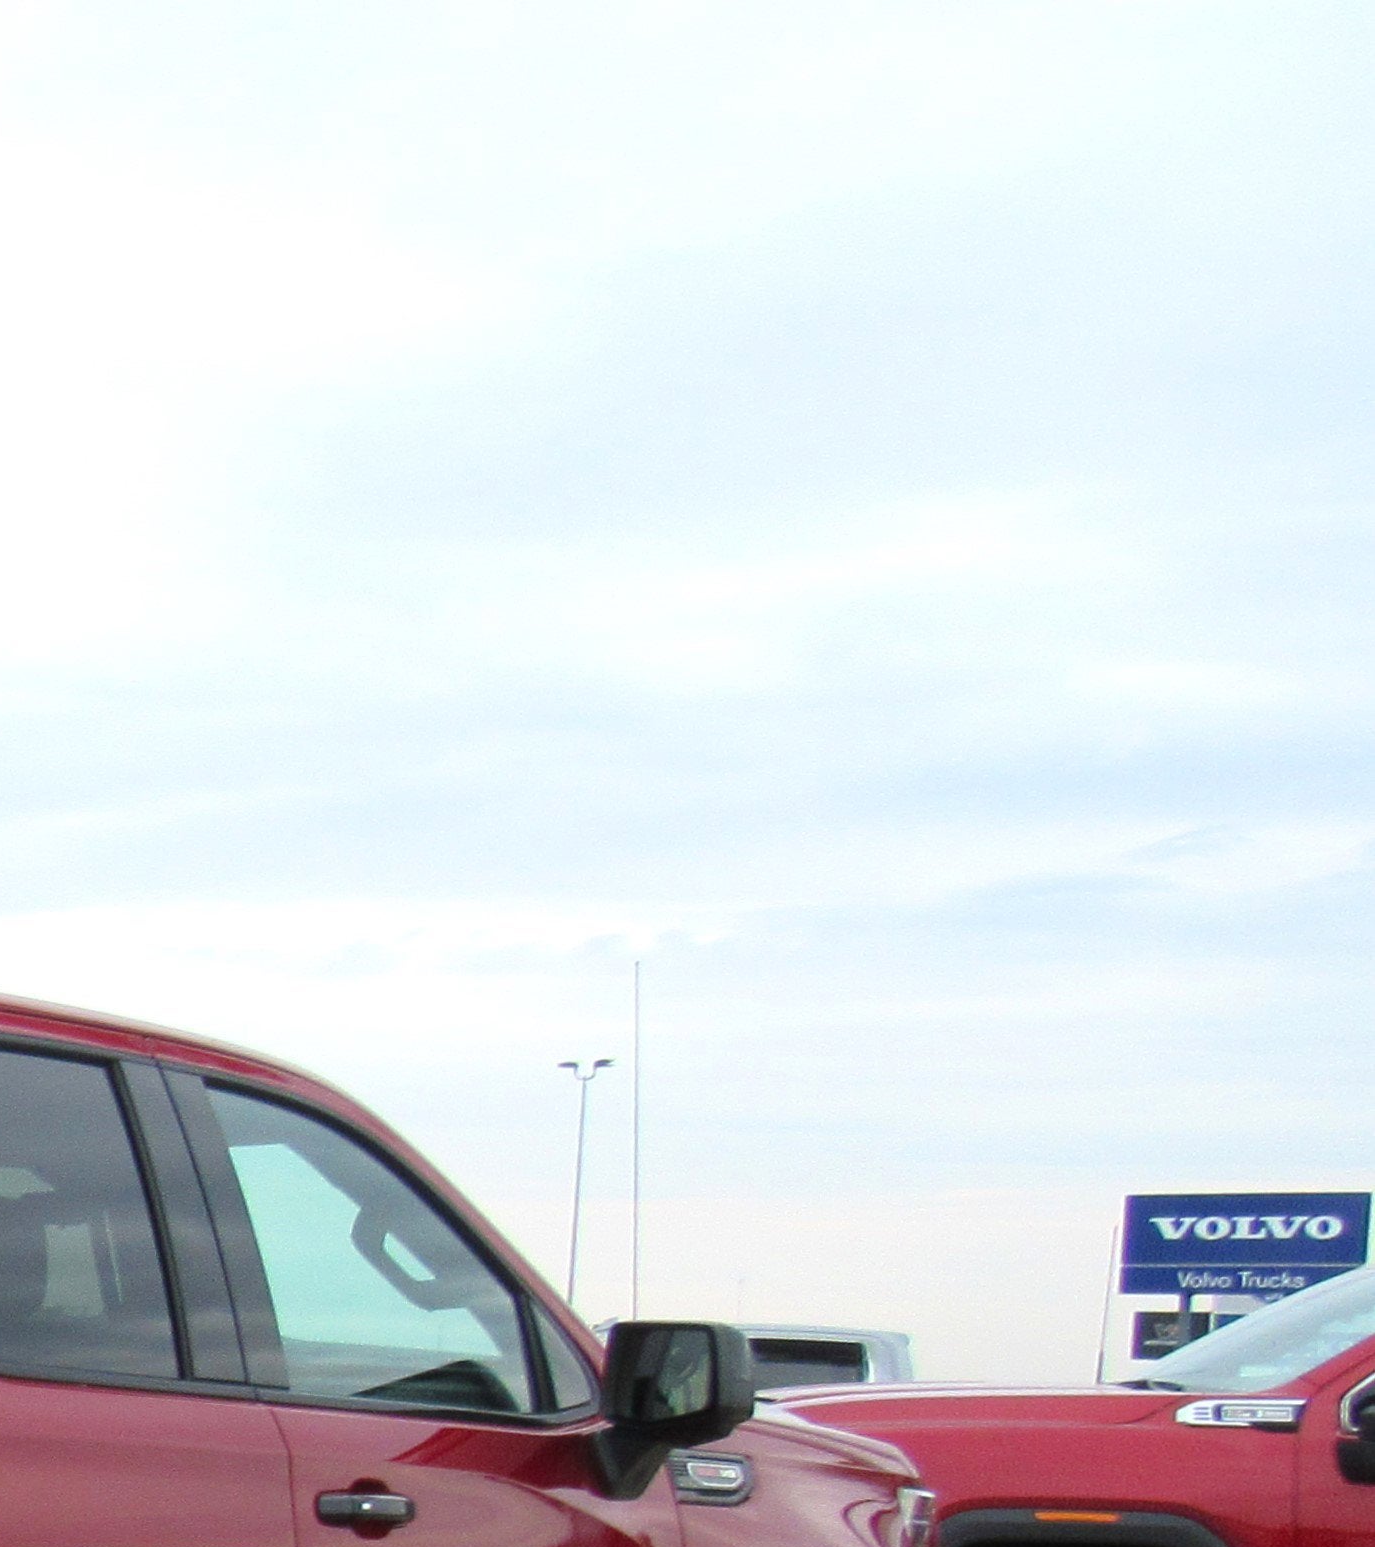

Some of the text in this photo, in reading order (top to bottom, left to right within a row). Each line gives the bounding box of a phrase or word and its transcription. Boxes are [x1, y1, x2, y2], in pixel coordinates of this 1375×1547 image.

[1148, 1215, 1344, 1241] VOLVO
[1176, 1270, 1306, 1289] Volvo Trucks
